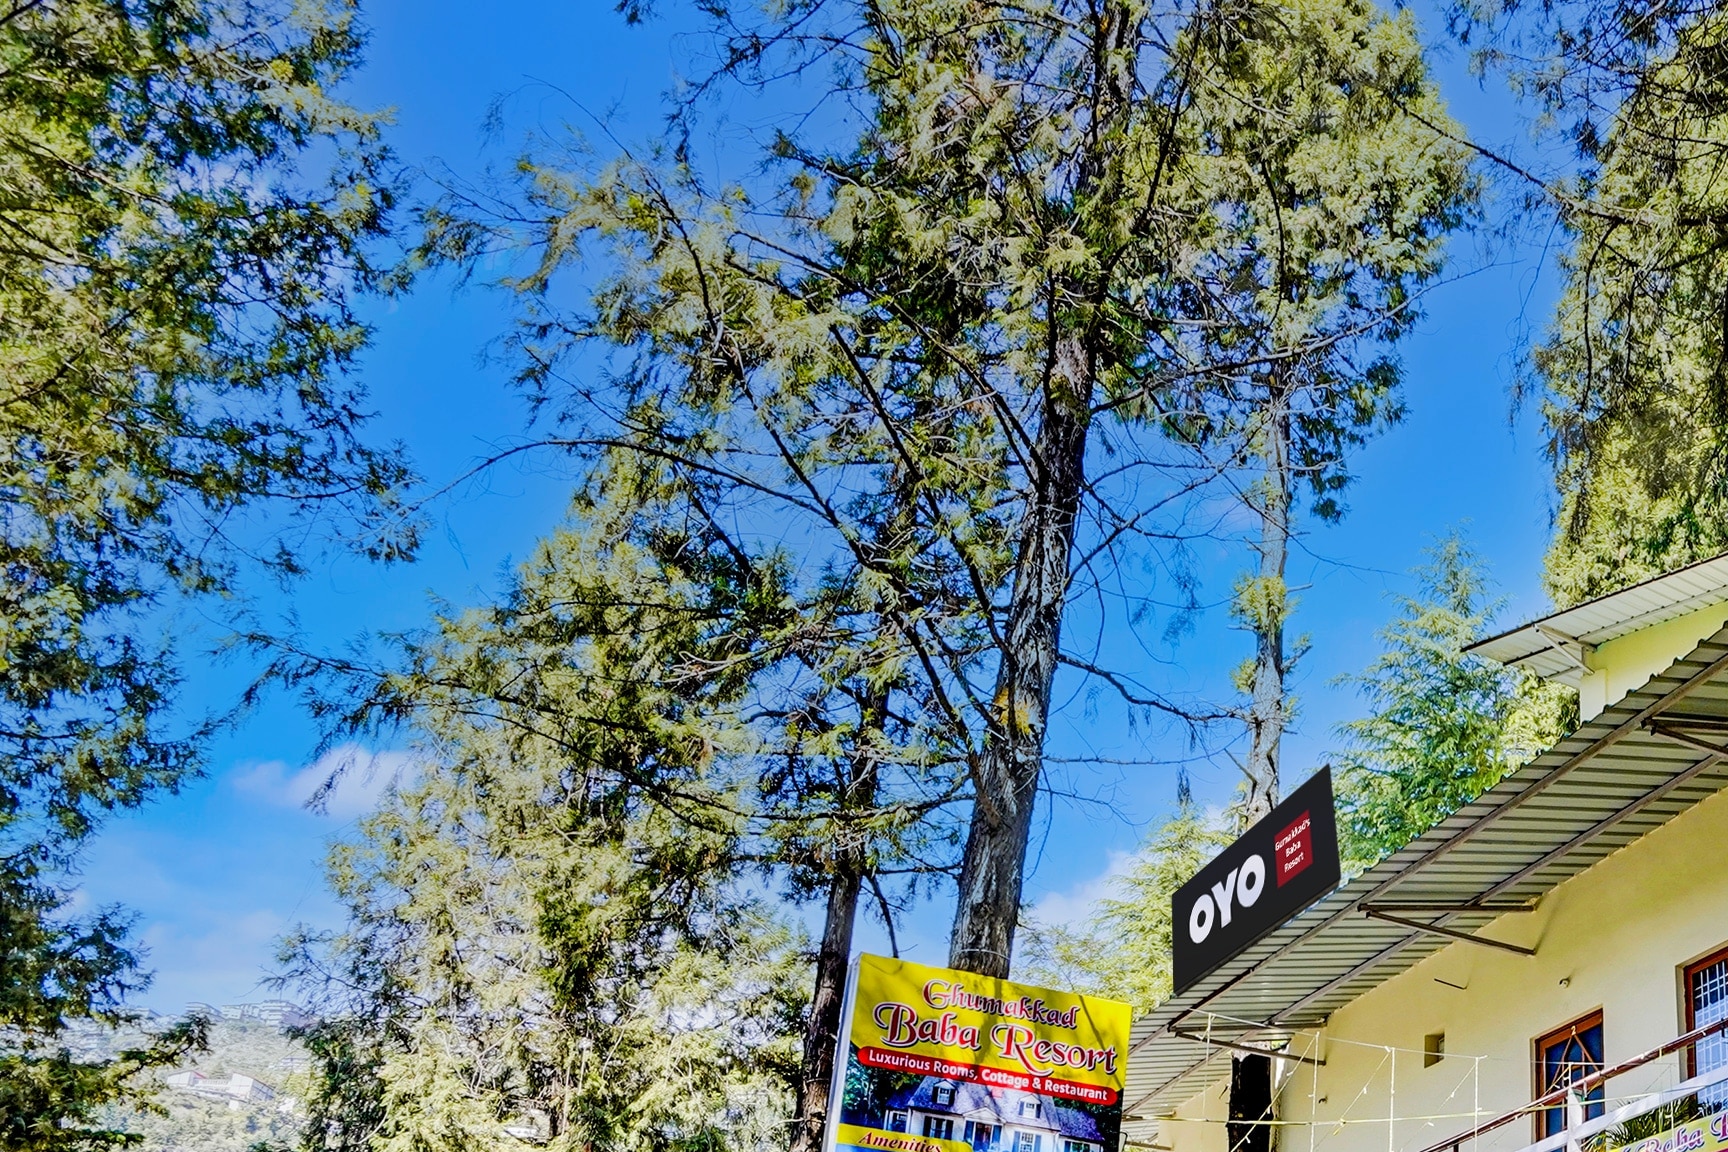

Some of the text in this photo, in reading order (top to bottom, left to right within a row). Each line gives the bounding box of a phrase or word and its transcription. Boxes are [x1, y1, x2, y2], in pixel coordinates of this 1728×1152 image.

[1284, 851, 1304, 873] Resort
[1286, 841, 1301, 857] Baba
[1189, 854, 1266, 944] OYO
[922, 978, 1080, 1029] Ghumakkad
[873, 1002, 1118, 1078] Baba Resort
[868, 1050, 1108, 1101] Luxurious Rooms, Cottage & Restaurant
